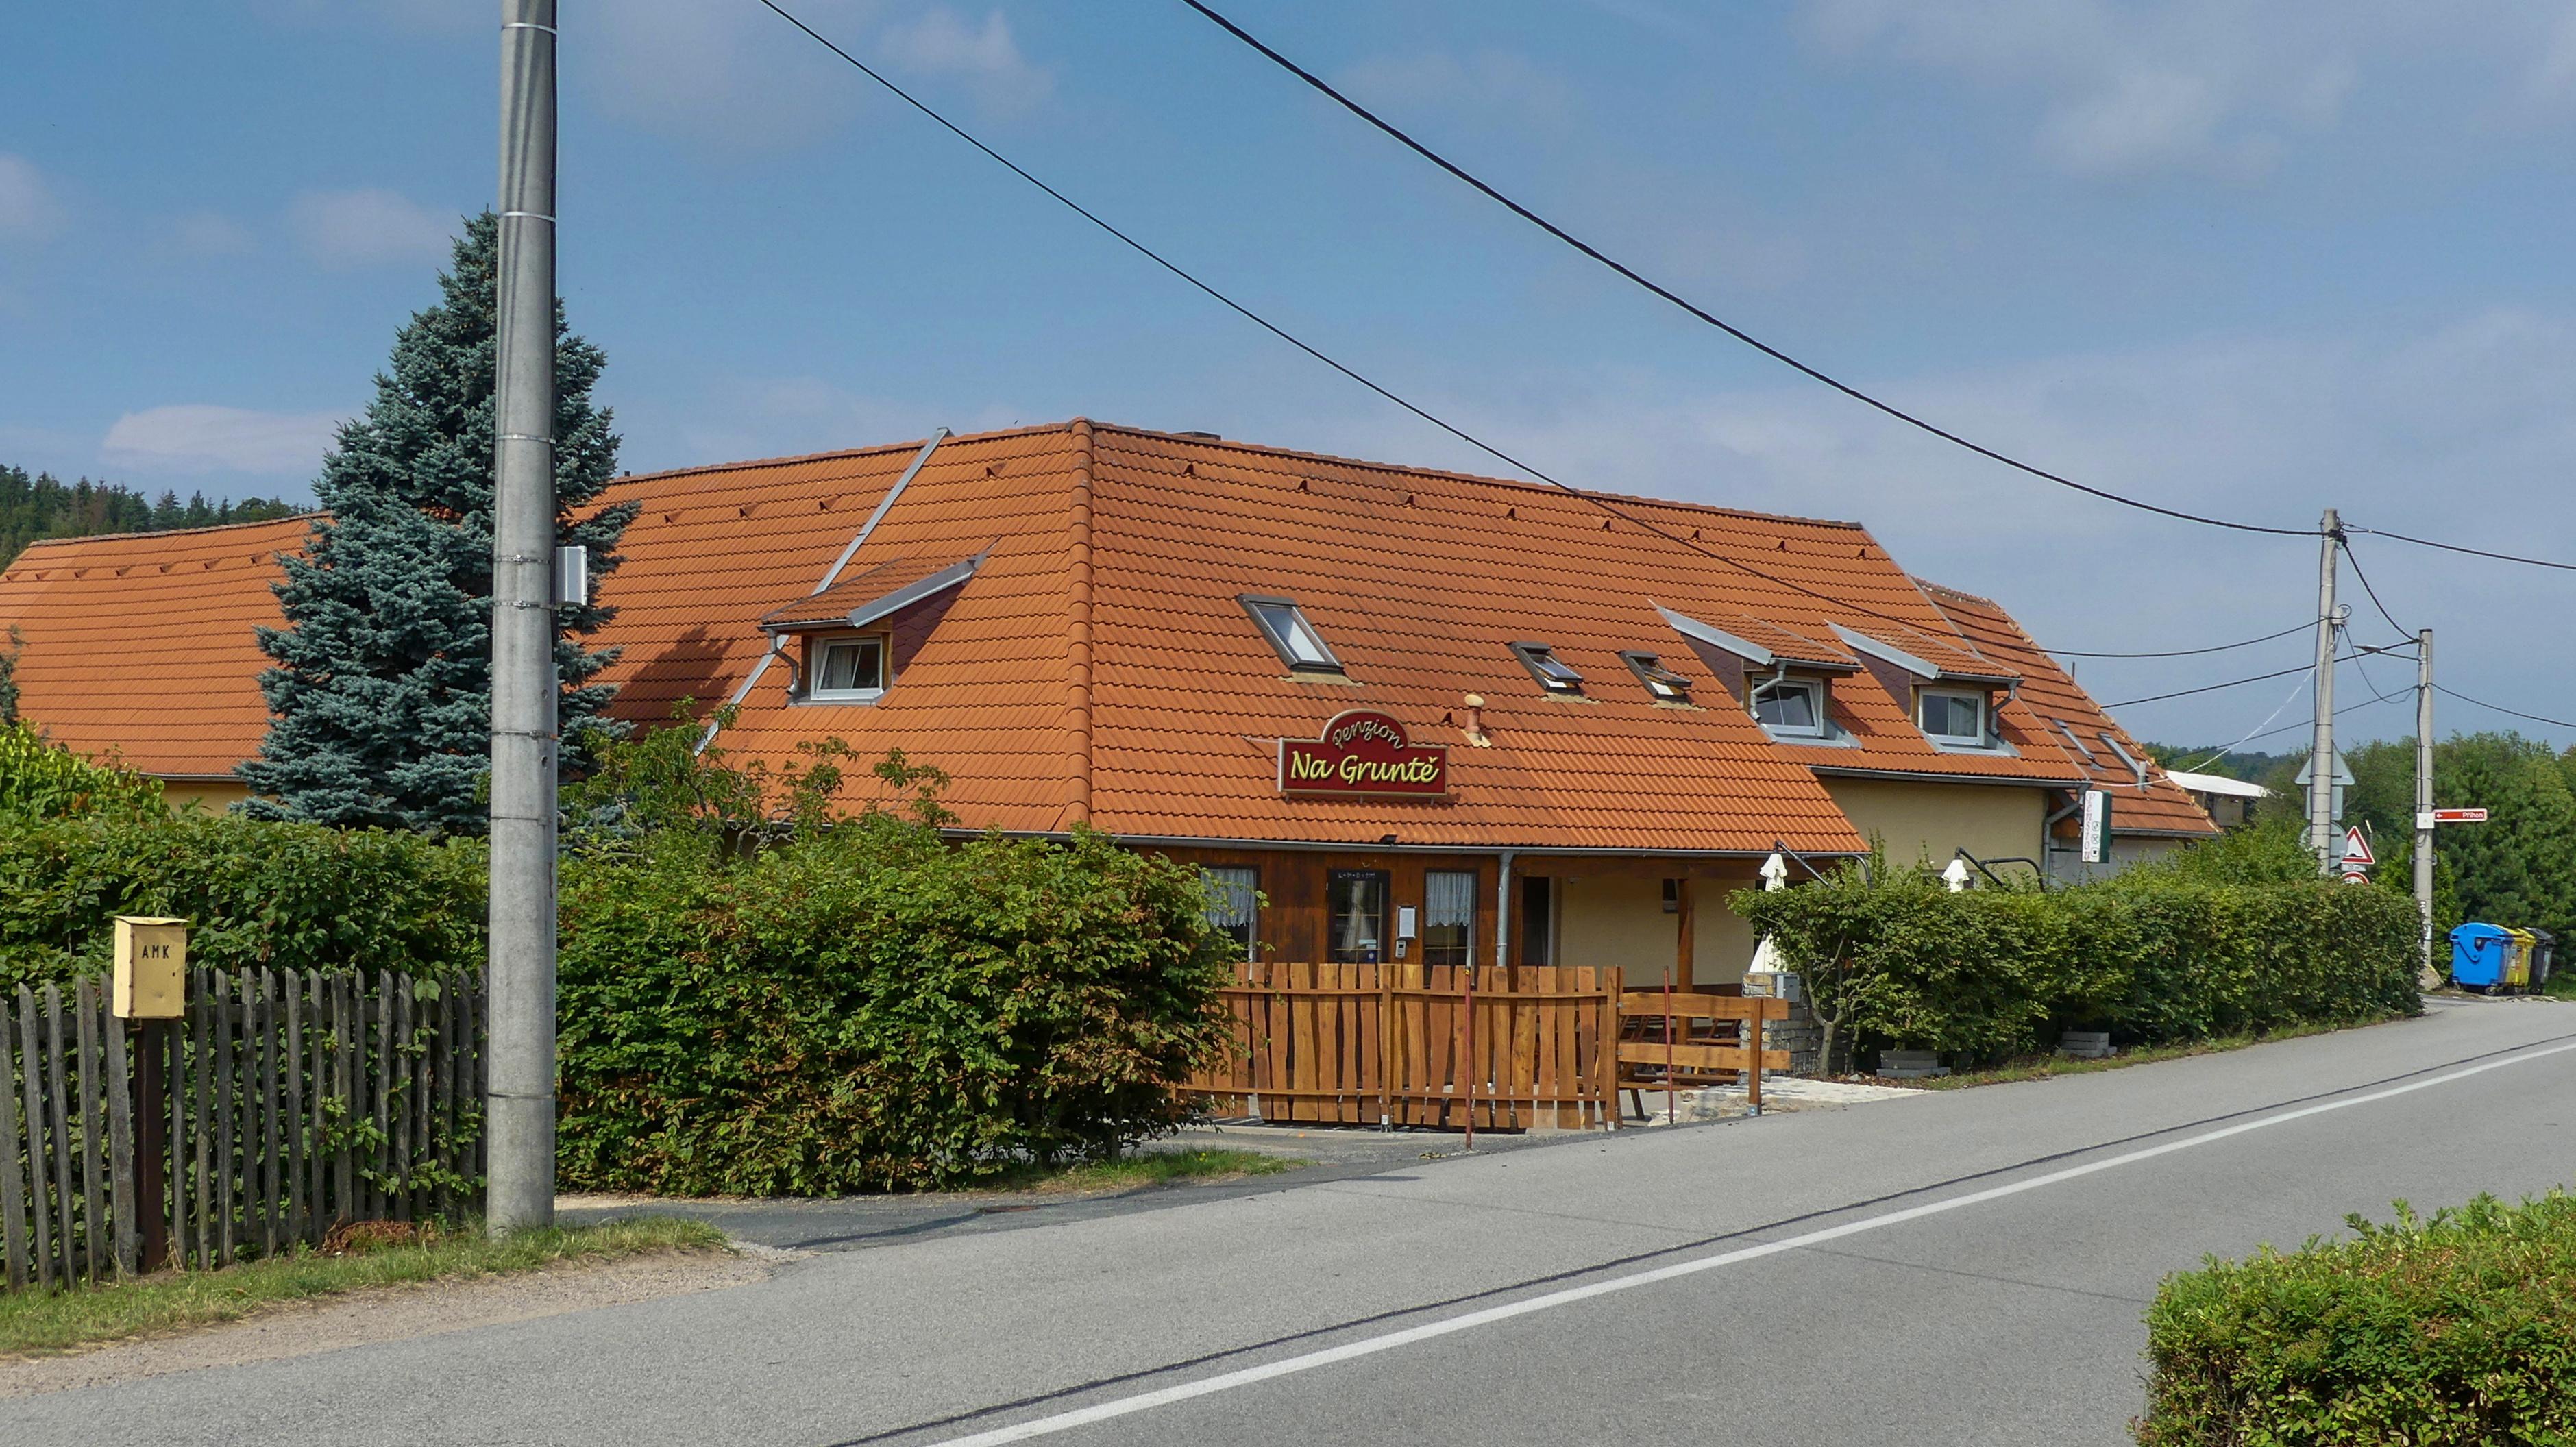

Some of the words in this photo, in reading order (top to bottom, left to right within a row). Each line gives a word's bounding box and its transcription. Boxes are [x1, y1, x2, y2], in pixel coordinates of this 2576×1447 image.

[1332, 719, 1404, 750] Penzion
[1290, 750, 1335, 780] Na
[1339, 754, 1440, 785] Gruntě
[142, 945, 170, 959] AMK
